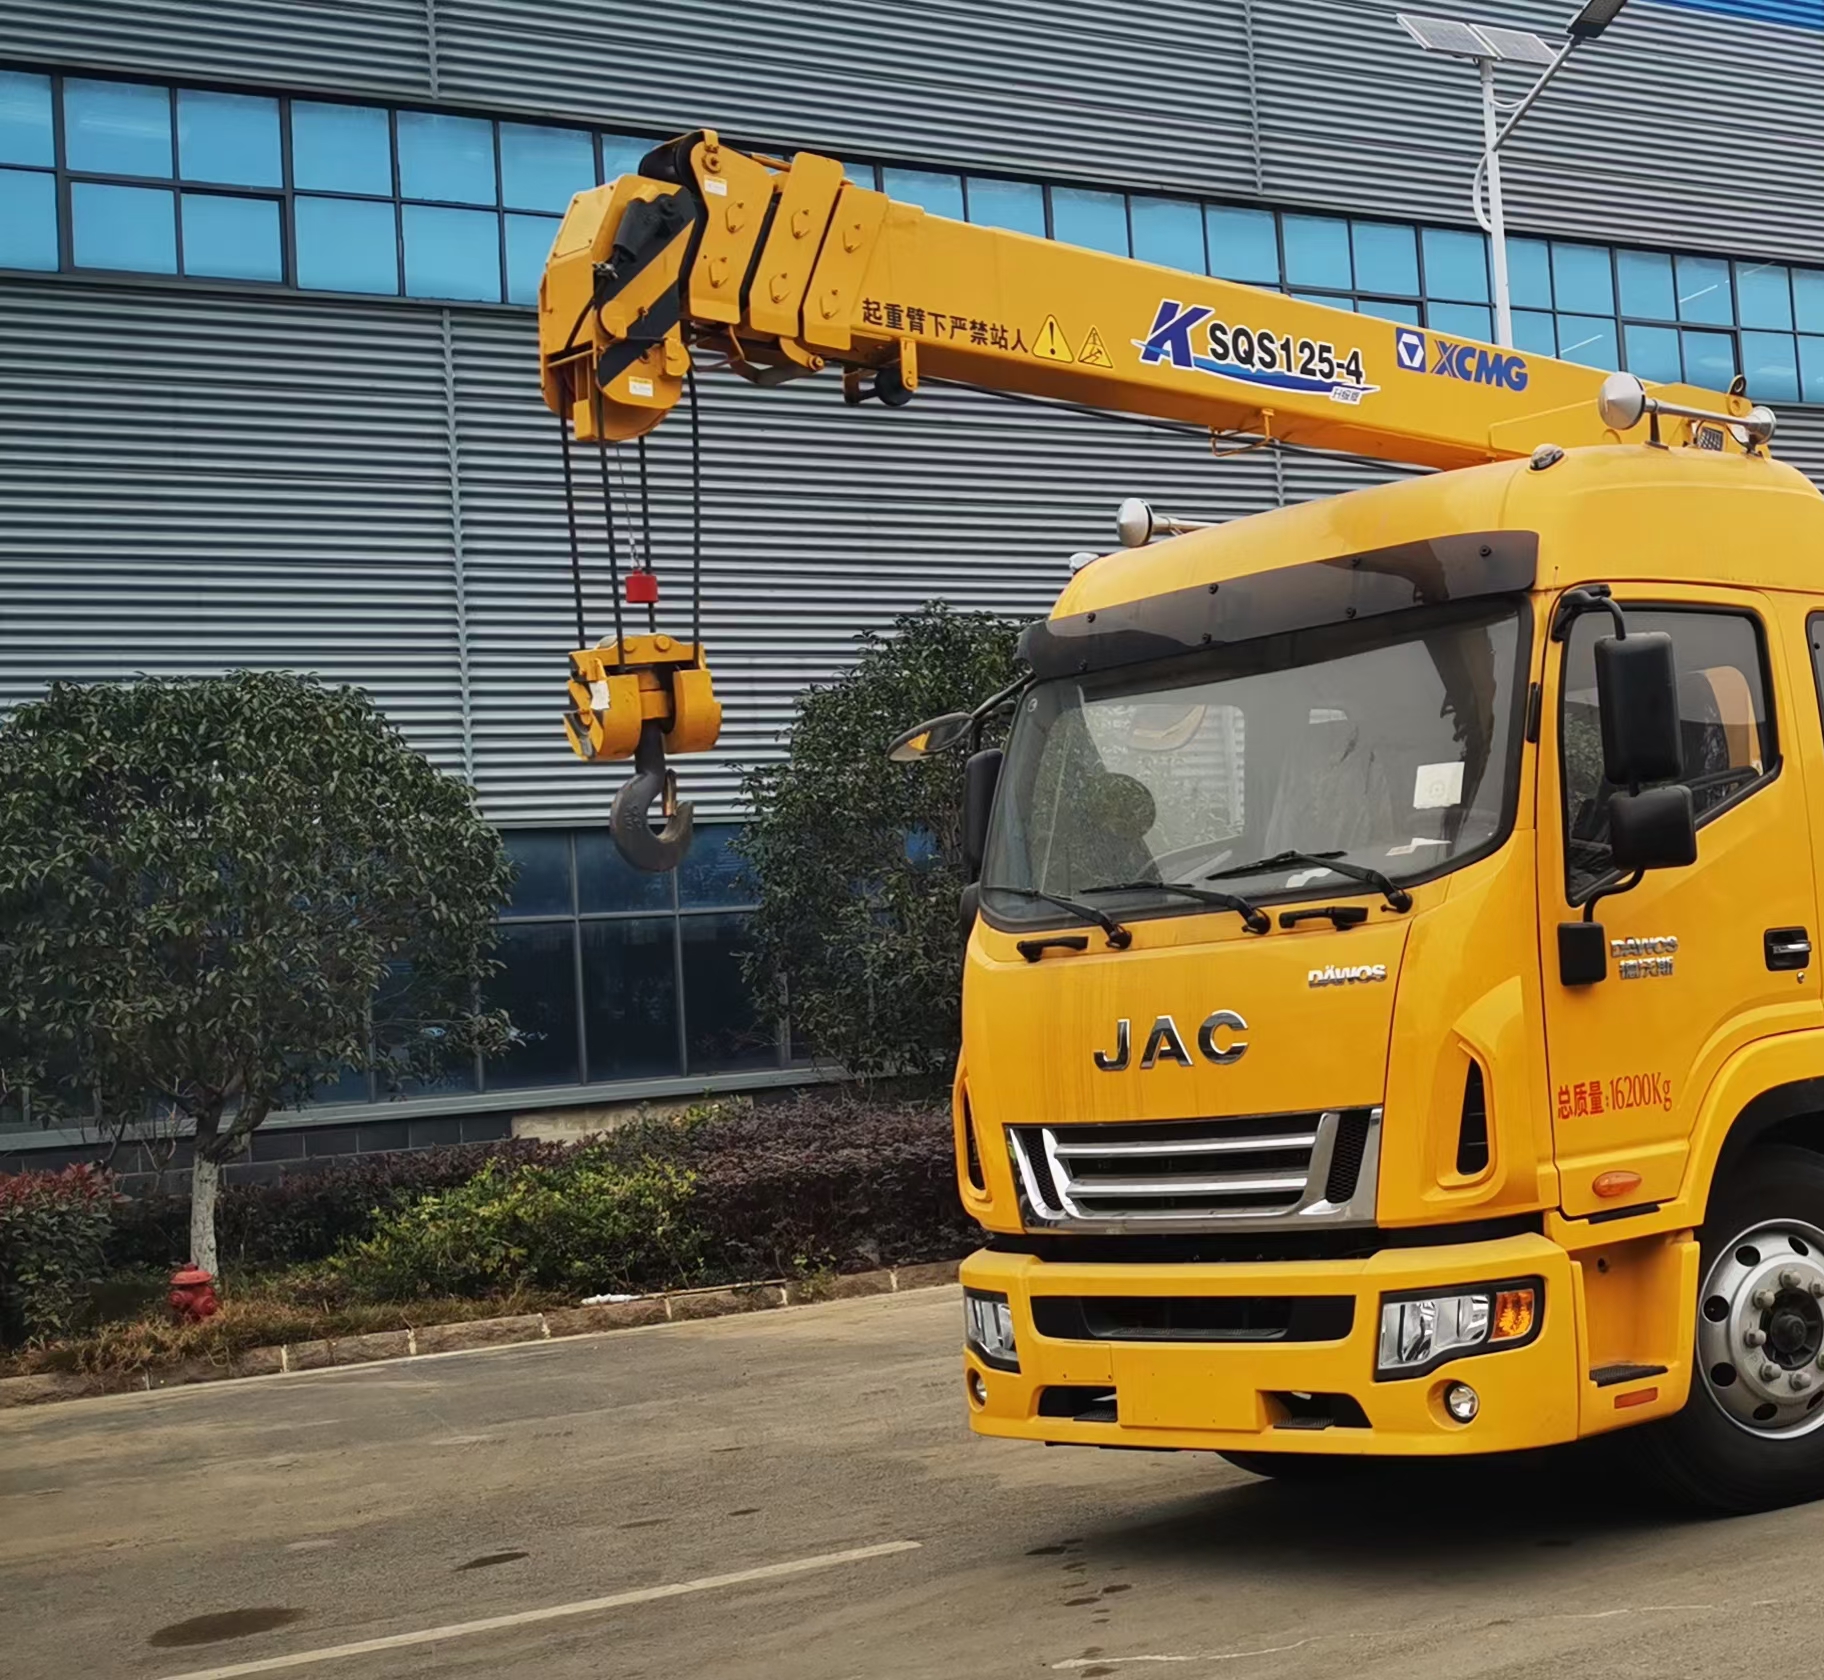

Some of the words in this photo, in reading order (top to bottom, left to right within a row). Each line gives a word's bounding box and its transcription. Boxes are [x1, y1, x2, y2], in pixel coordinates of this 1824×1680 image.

[862, 297, 1029, 354] 起重臂下严禁站人
[1140, 300, 1213, 368] K
[1209, 322, 1364, 385] SQS125-4
[1430, 339, 1529, 392] XCMG
[1093, 1009, 1249, 1072] JAC
